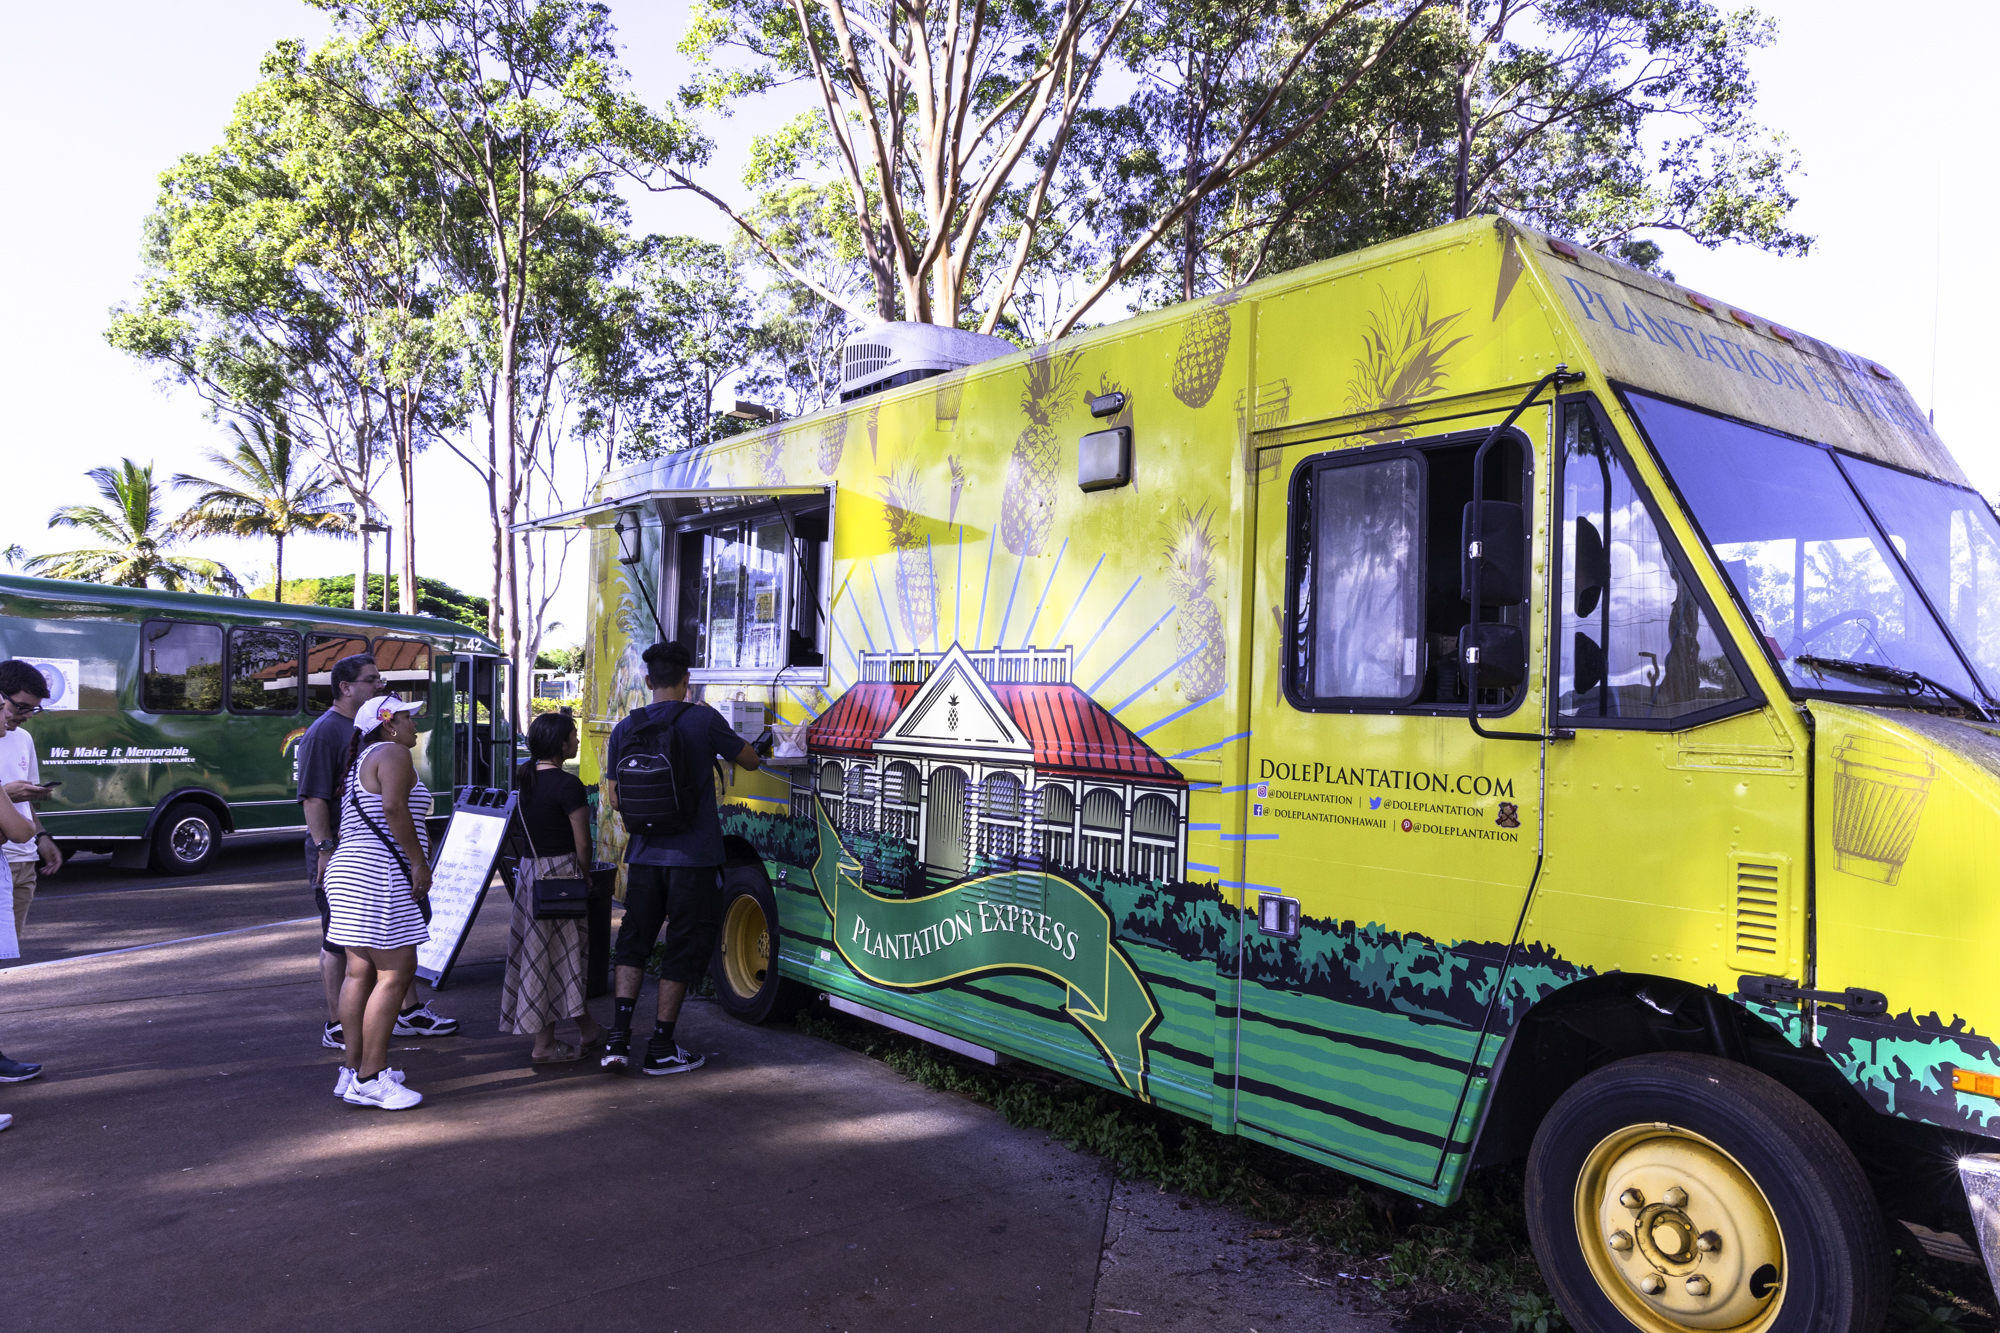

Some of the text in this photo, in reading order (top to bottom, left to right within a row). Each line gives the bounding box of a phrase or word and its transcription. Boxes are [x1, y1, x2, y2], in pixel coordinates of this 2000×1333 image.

[1562, 274, 1931, 437] PLANTATION EXPRESS
[42, 757, 196, 766] www.memorytourshawaii.square.site
[50, 746, 189, 758] We Make it Memorable
[1268, 789, 1484, 818] @DOLEPLANTATION @DOLEPLANTATION
[1413, 822, 1519, 843] @DOLEPLANTATION
[851, 901, 1080, 961] PLANTATION EXPRESS
